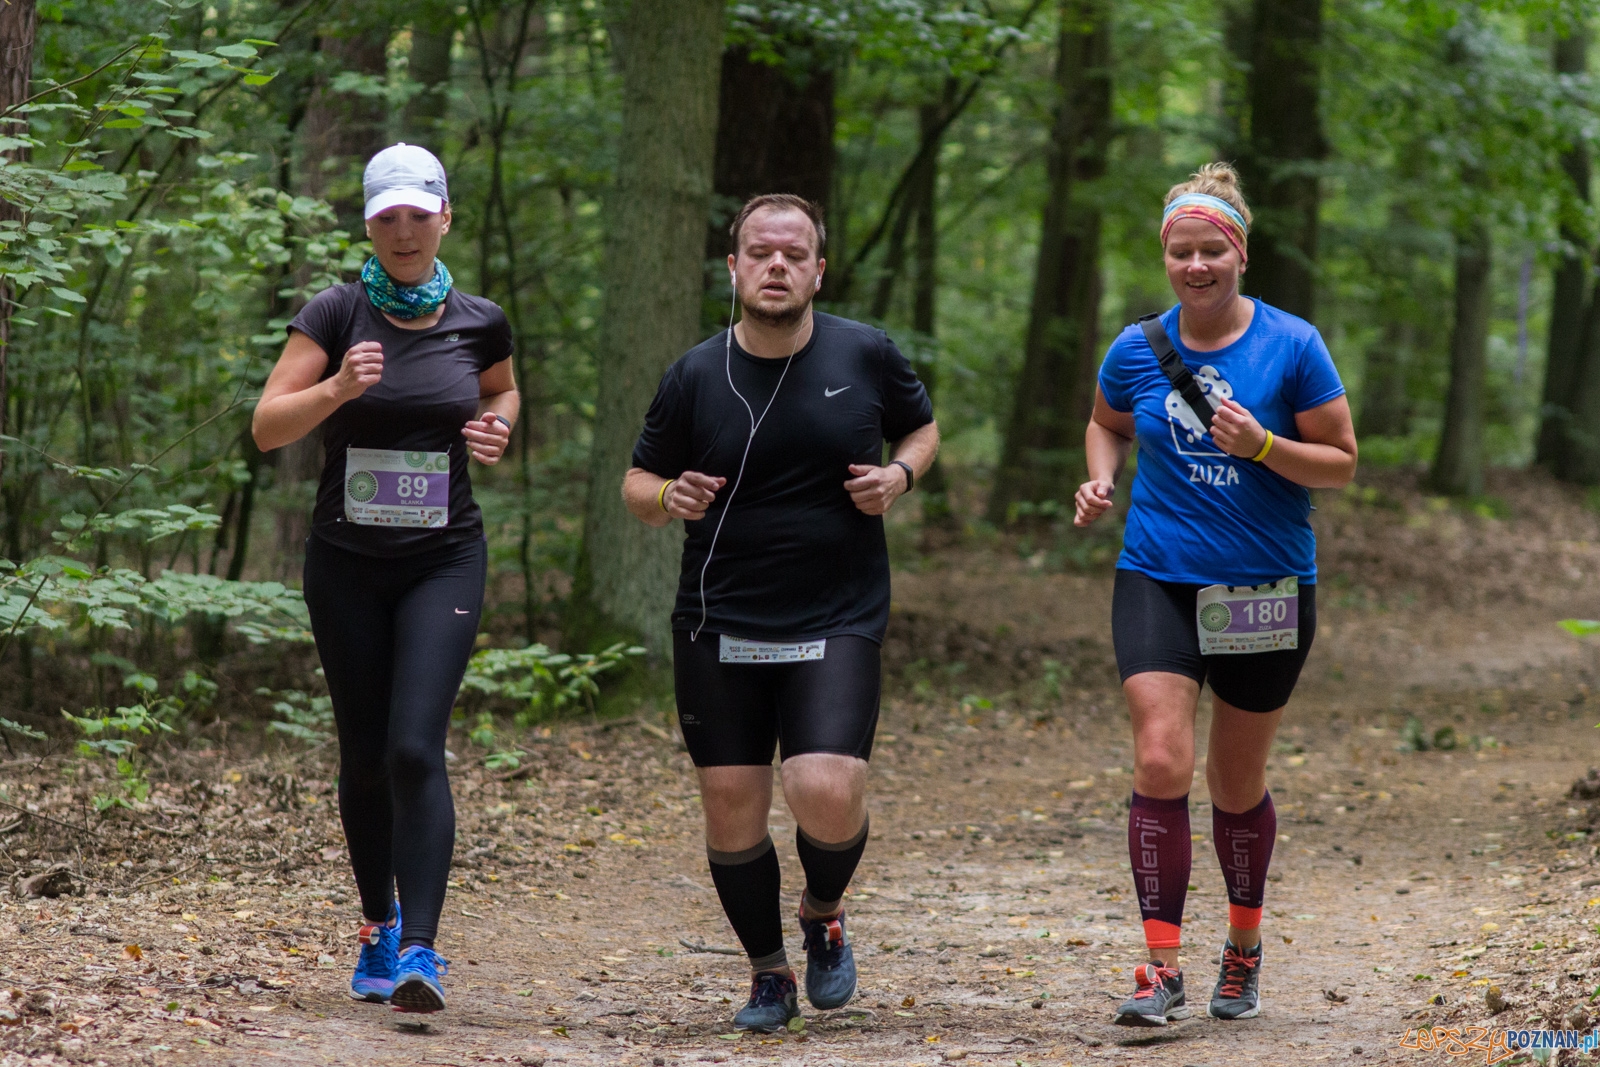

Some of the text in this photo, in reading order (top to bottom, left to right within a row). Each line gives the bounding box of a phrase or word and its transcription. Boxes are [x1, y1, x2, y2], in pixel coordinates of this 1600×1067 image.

[397, 475, 428, 498] 89
[1187, 463, 1240, 486] ZUZA
[1243, 600, 1287, 625] 180
[1136, 816, 1168, 911] kalenji
[1225, 827, 1259, 901] kalenji
